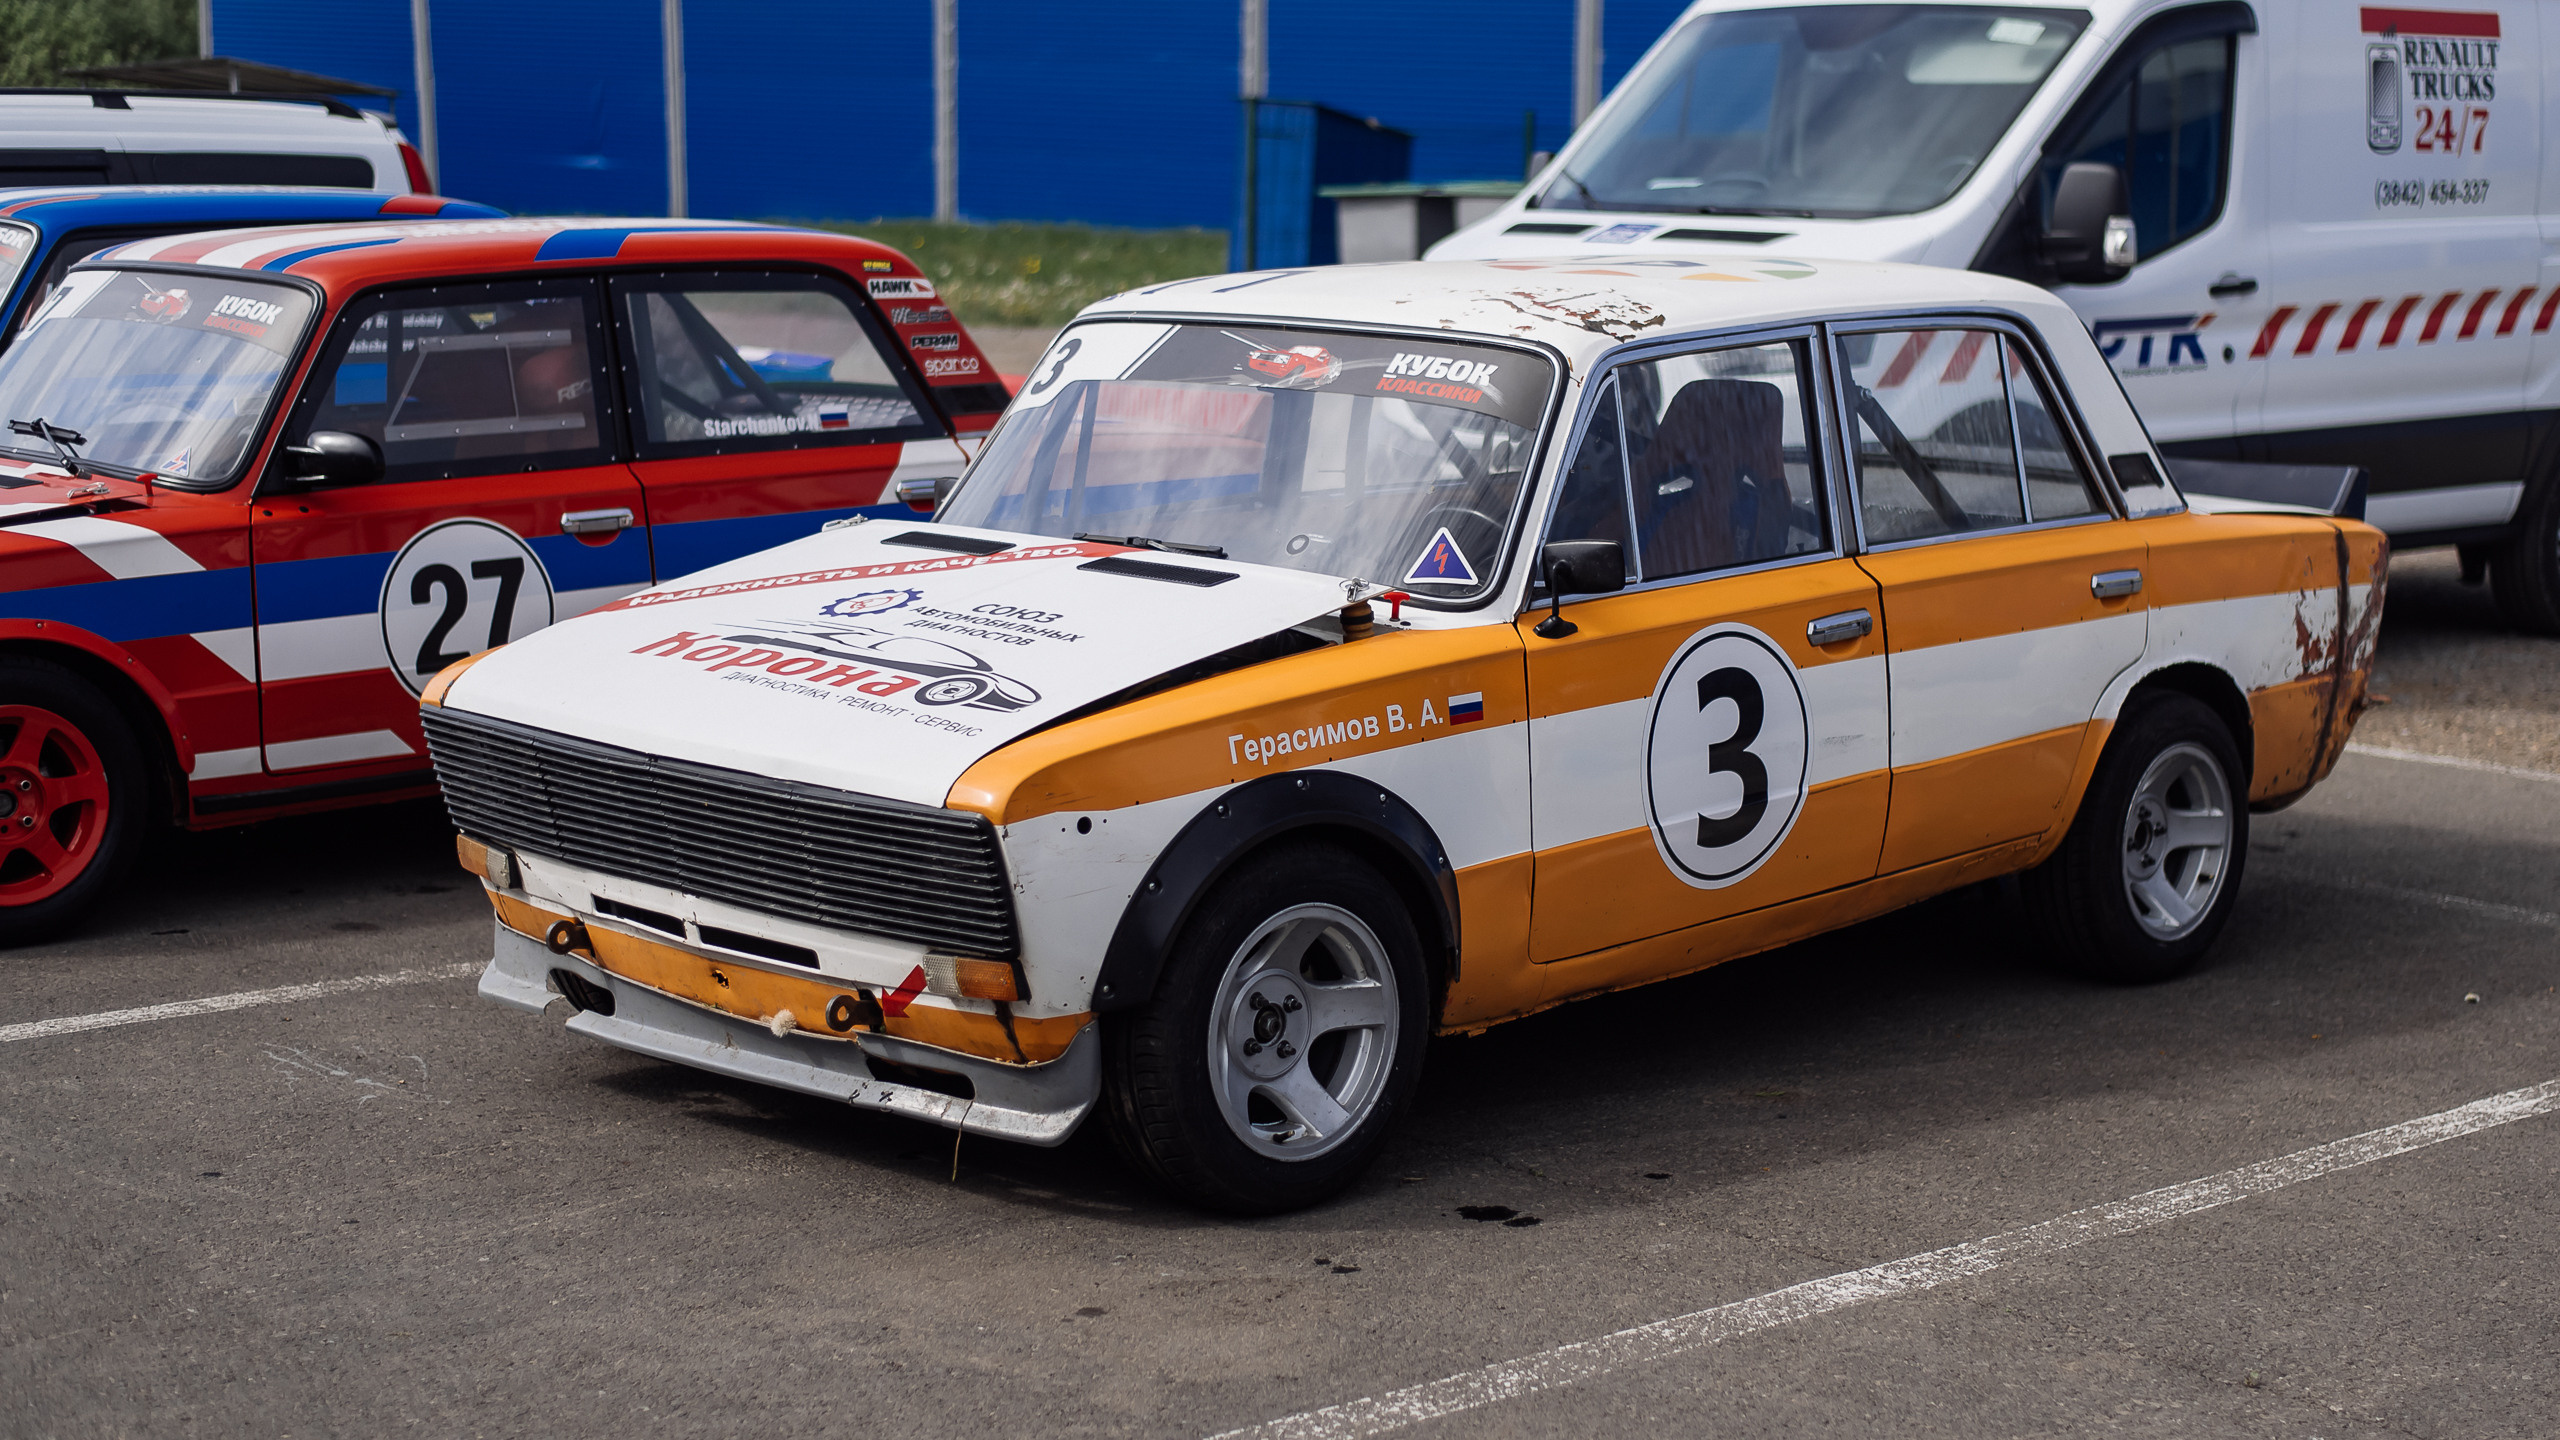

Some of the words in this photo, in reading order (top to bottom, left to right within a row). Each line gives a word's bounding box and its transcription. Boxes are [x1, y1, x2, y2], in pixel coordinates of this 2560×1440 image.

[2403, 39, 2498, 69] RENAULT
[2409, 71, 2495, 101] TRUCKS
[2416, 105, 2489, 158] 24/7
[2375, 179, 2425, 210] (3842)
[2430, 178, 2490, 206] 454-337
[870, 281, 912, 293] HAWK
[214, 294, 283, 325] КУБОК
[924, 357, 979, 376] sparco
[1031, 338, 1082, 395] 3
[1386, 352, 1498, 387] КУБОК
[1376, 377, 1483, 404] КЛАССИКИ
[628, 569, 859, 607] НАДЕЖНОСТЬ
[868, 564, 897, 576] И
[411, 557, 525, 675] 27
[909, 605, 1085, 643] АВТОМОБИЛЬНЫХ
[972, 603, 1064, 624] СОЮЗ
[903, 619, 1036, 646] ДИАГНОСТОВ
[629, 631, 921, 698] Корона
[722, 671, 830, 701] ДИАГНОСТИКА
[838, 694, 909, 718] РЕМОНТ
[914, 713, 983, 738] СЕРВИС
[1228, 715, 1380, 765] Герасимов
[1386, 703, 1413, 733] В.
[1420, 698, 1444, 727] А.
[1697, 667, 1769, 848] 3
